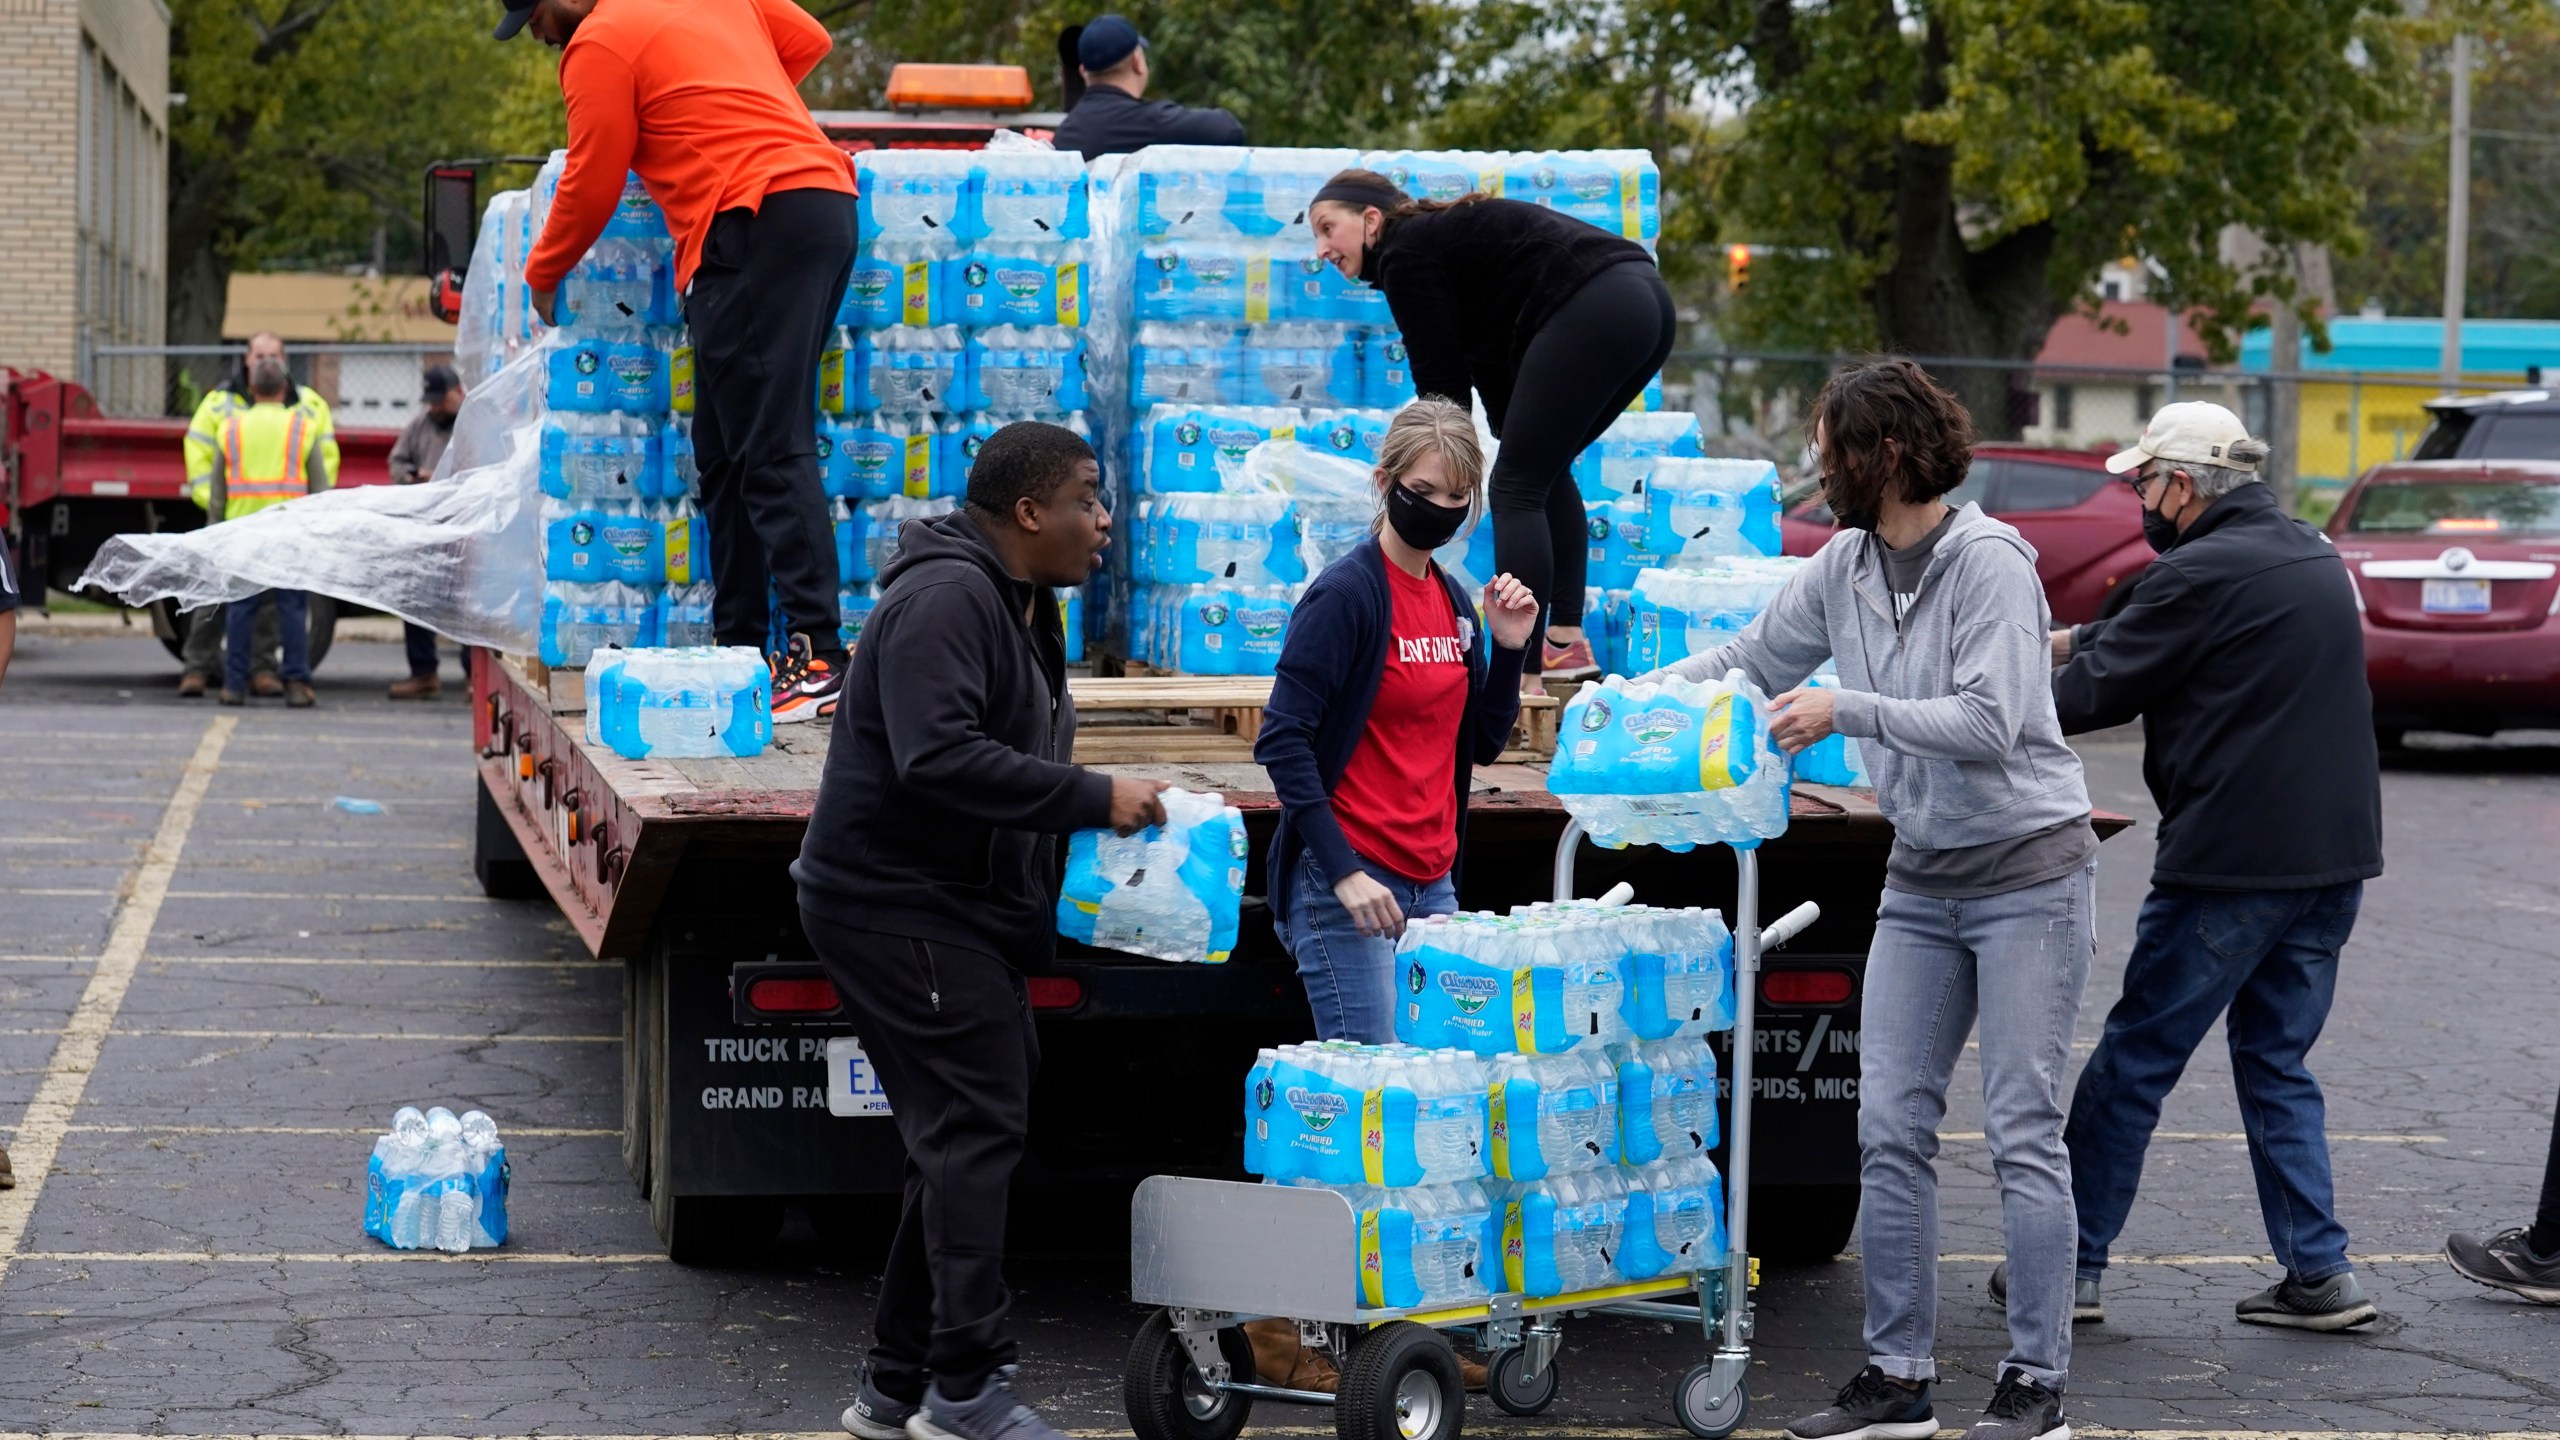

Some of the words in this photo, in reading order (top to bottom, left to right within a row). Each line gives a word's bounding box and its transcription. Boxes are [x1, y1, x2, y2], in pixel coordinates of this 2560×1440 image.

[1398, 636, 1431, 663] LIVE
[704, 1038, 790, 1062] TRUCK
[701, 1087, 784, 1109] GRAND
[792, 1087, 829, 1108] RA
[1716, 1077, 1807, 1104] RPIDS,
[1814, 1077, 1861, 1099] MIC
